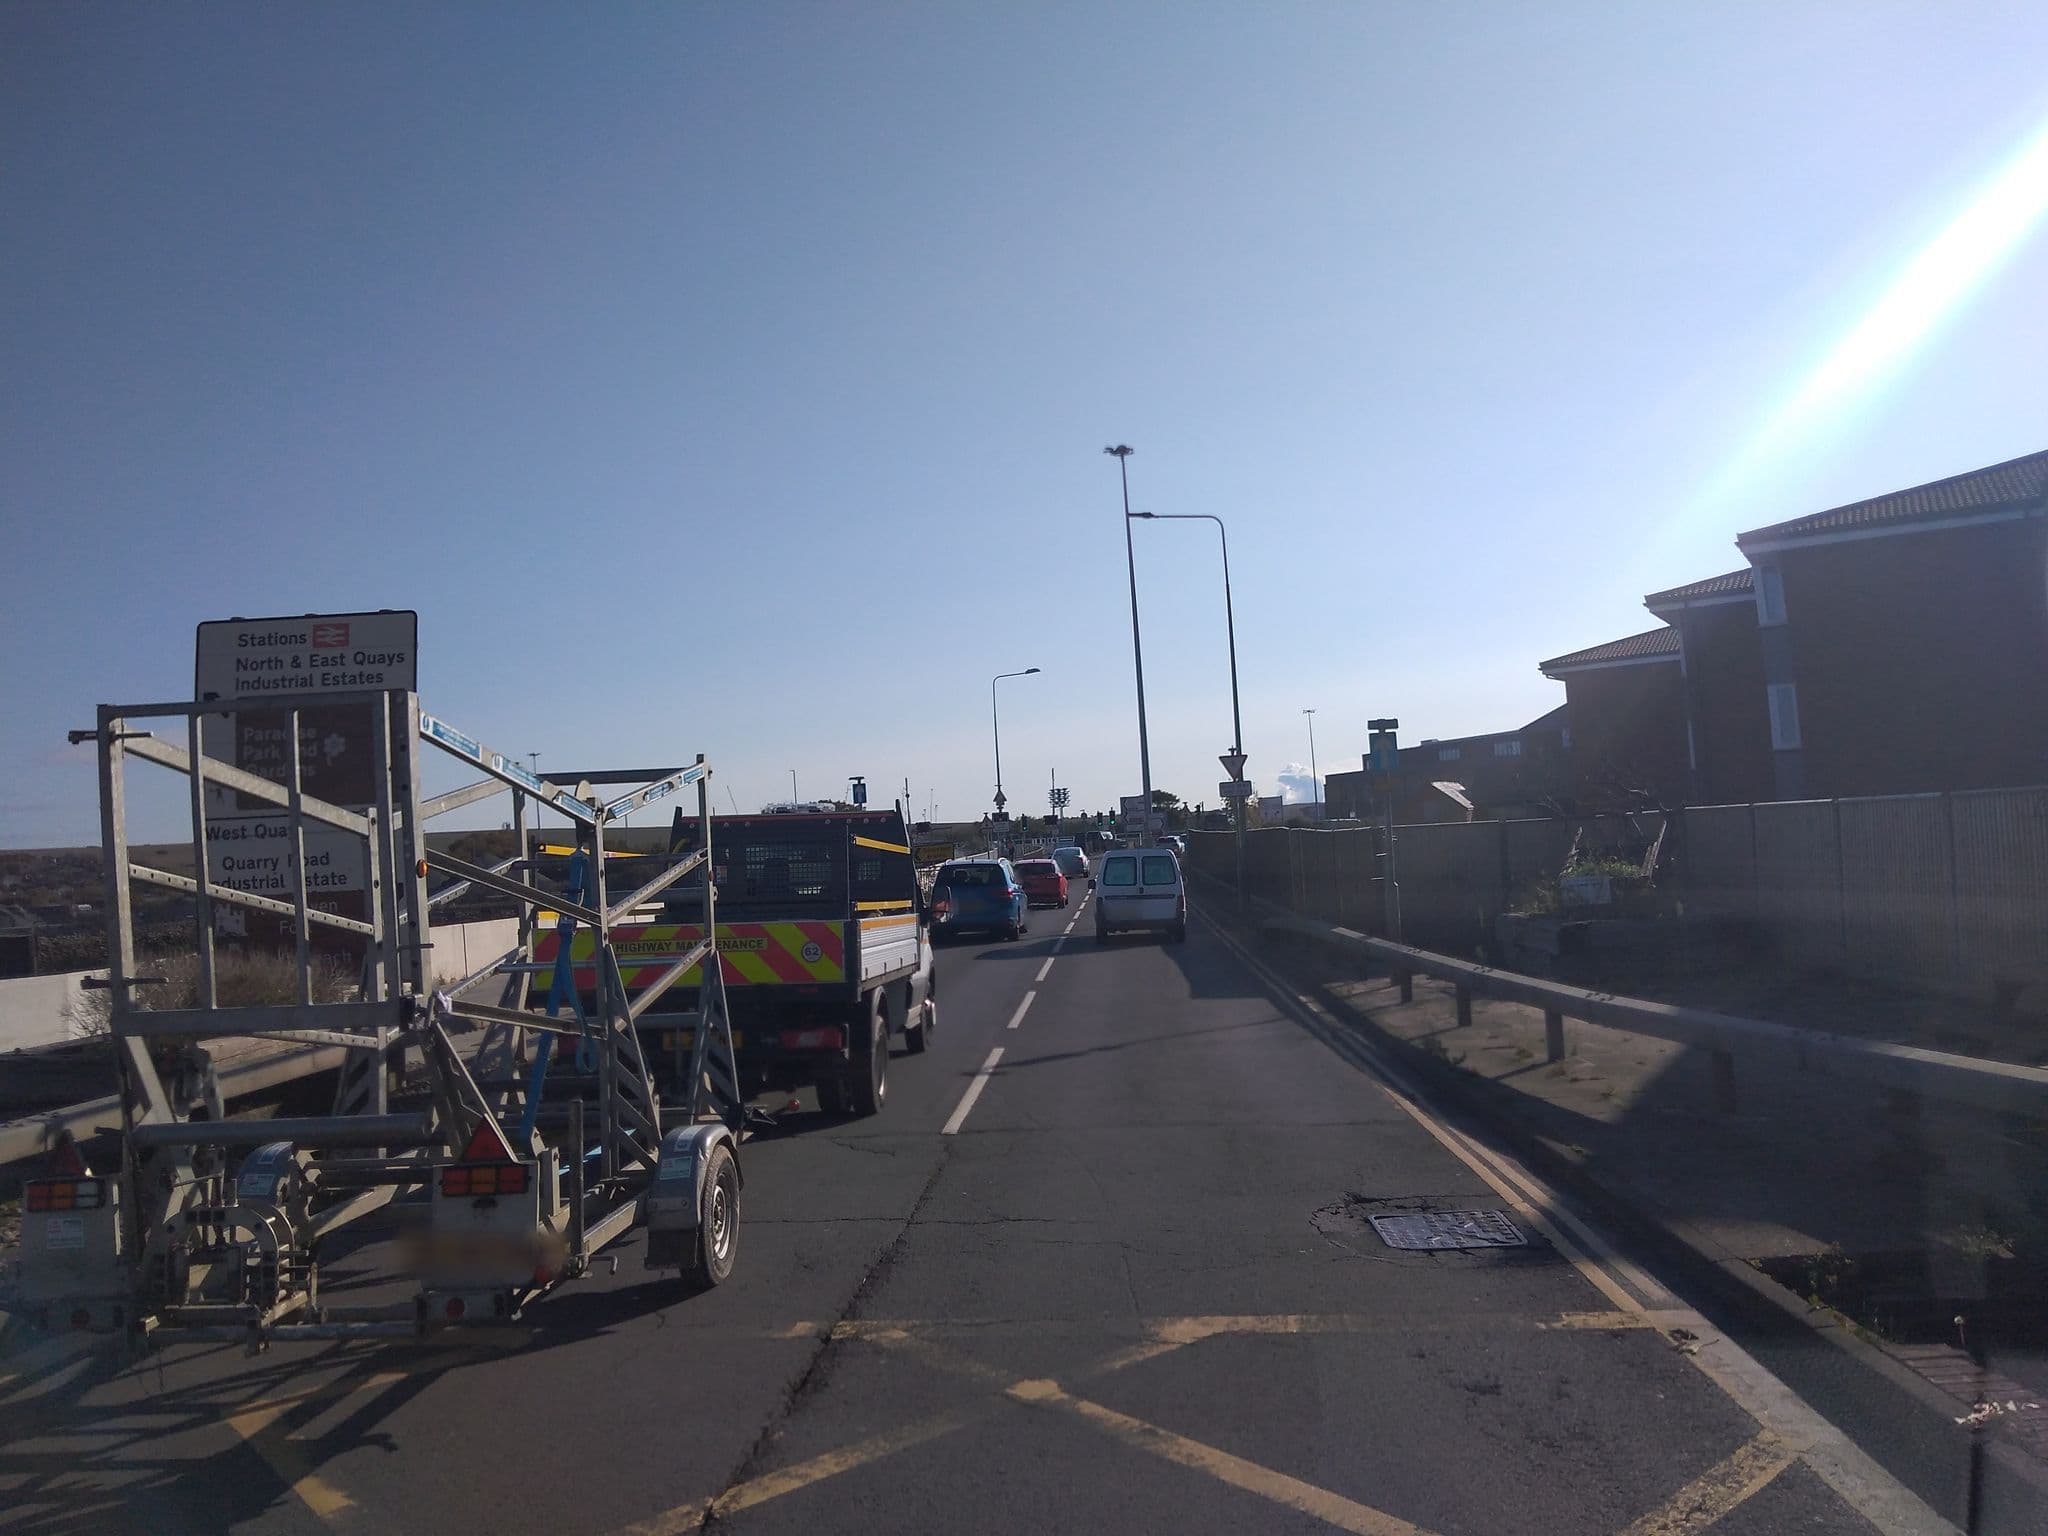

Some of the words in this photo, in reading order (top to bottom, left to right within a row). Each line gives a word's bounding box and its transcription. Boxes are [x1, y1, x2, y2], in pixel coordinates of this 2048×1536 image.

[238, 633, 307, 647] Stations
[236, 656, 283, 672] North
[290, 655, 301, 669] &
[309, 653, 346, 668] East
[353, 651, 405, 667] Quays
[235, 674, 314, 691] Industrial
[321, 671, 384, 686] Estates
[243, 745, 281, 760] Park
[206, 825, 247, 840] West
[254, 823, 288, 839] Qua
[222, 855, 279, 871] Quarry
[304, 873, 347, 887] state
[616, 940, 672, 953] HIGHWAY
[804, 947, 820, 957] 62
